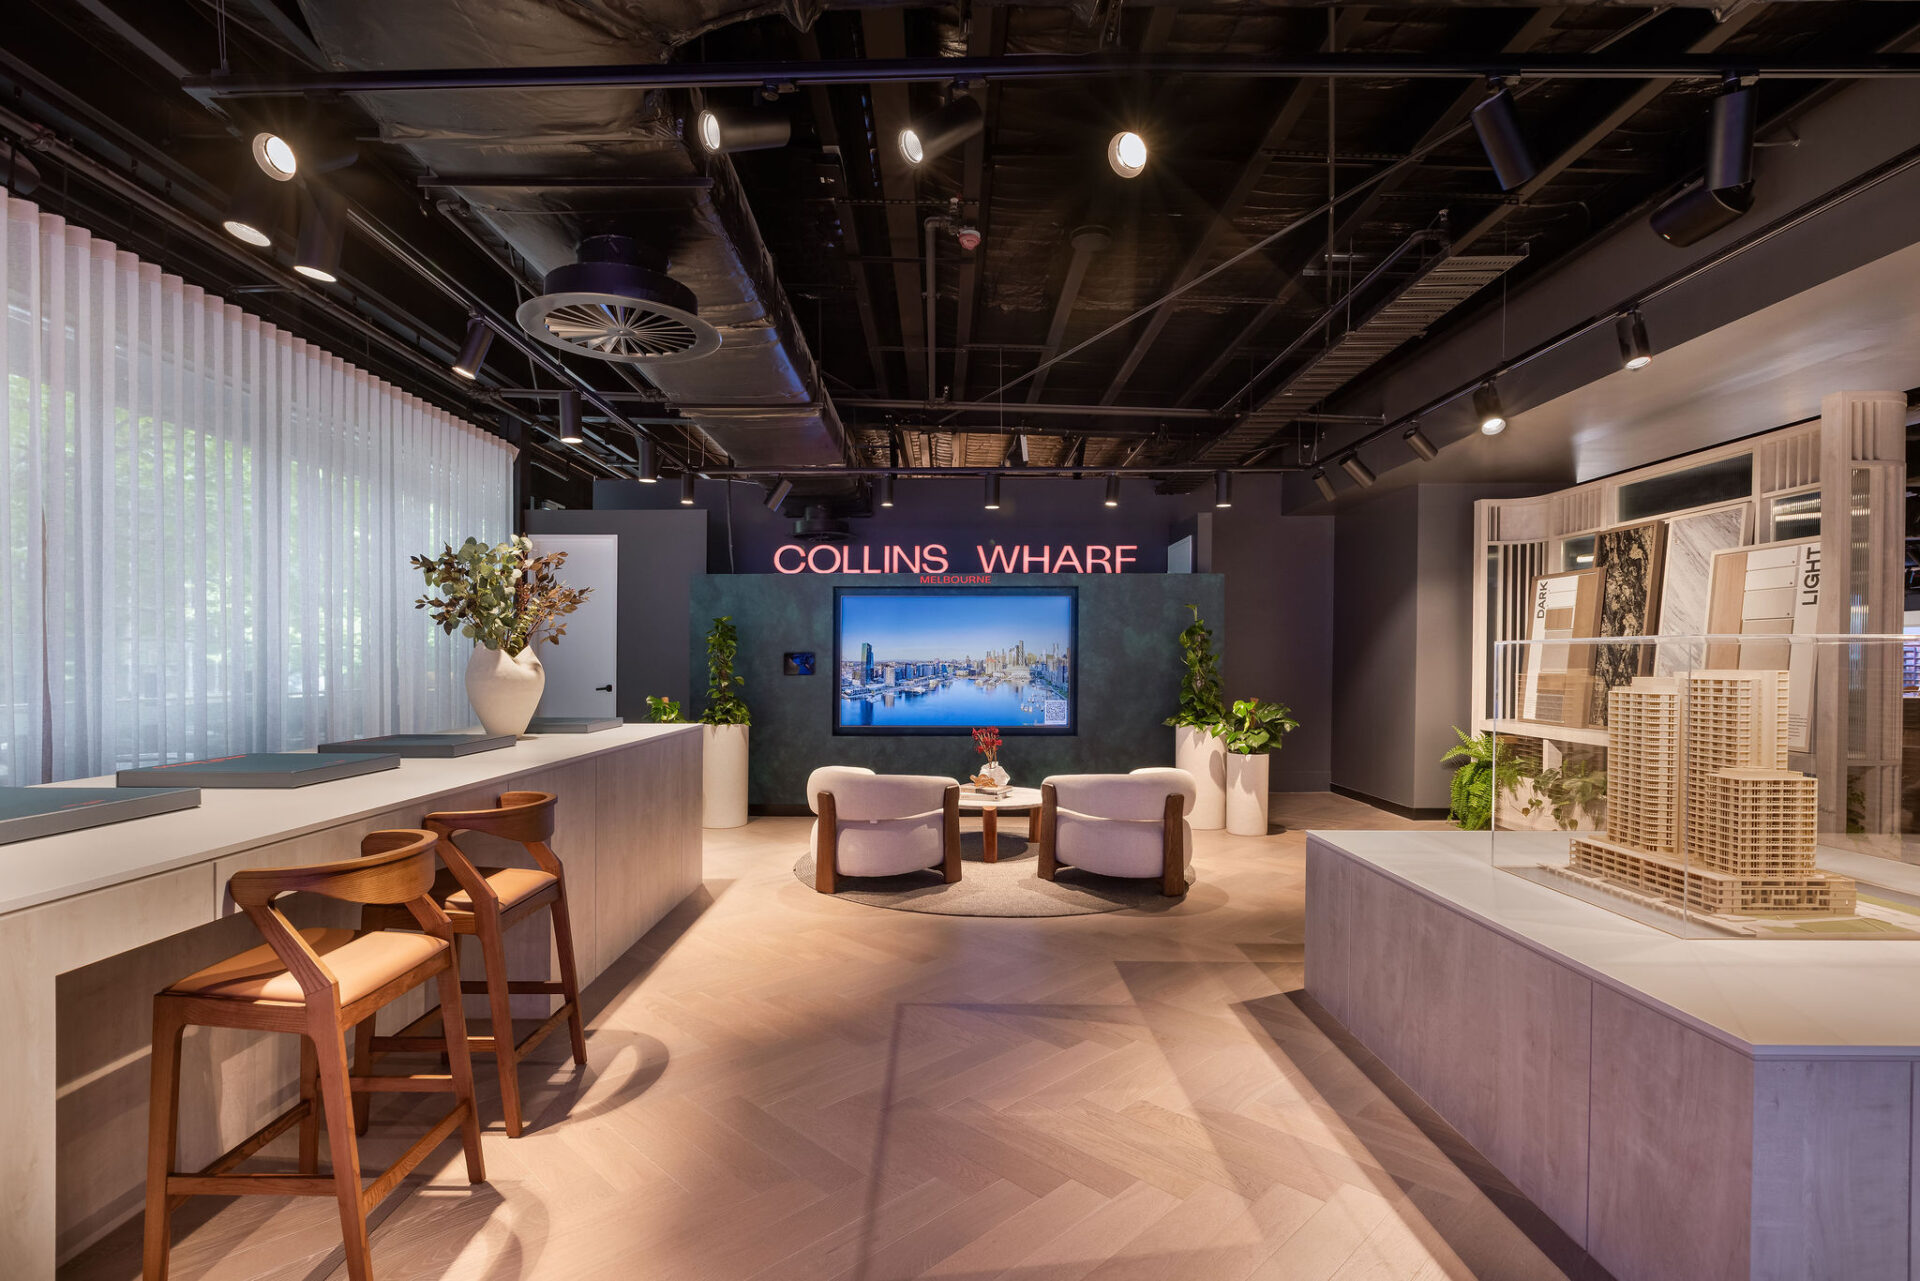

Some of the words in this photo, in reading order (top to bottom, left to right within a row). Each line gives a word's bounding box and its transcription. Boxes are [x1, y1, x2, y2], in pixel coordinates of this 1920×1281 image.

[773, 544, 949, 574] COLLINS
[976, 545, 1138, 574] WHARF
[1802, 546, 1821, 606] LIGHT
[920, 575, 992, 584] MELBOURNE
[1536, 580, 1549, 619] DARK
